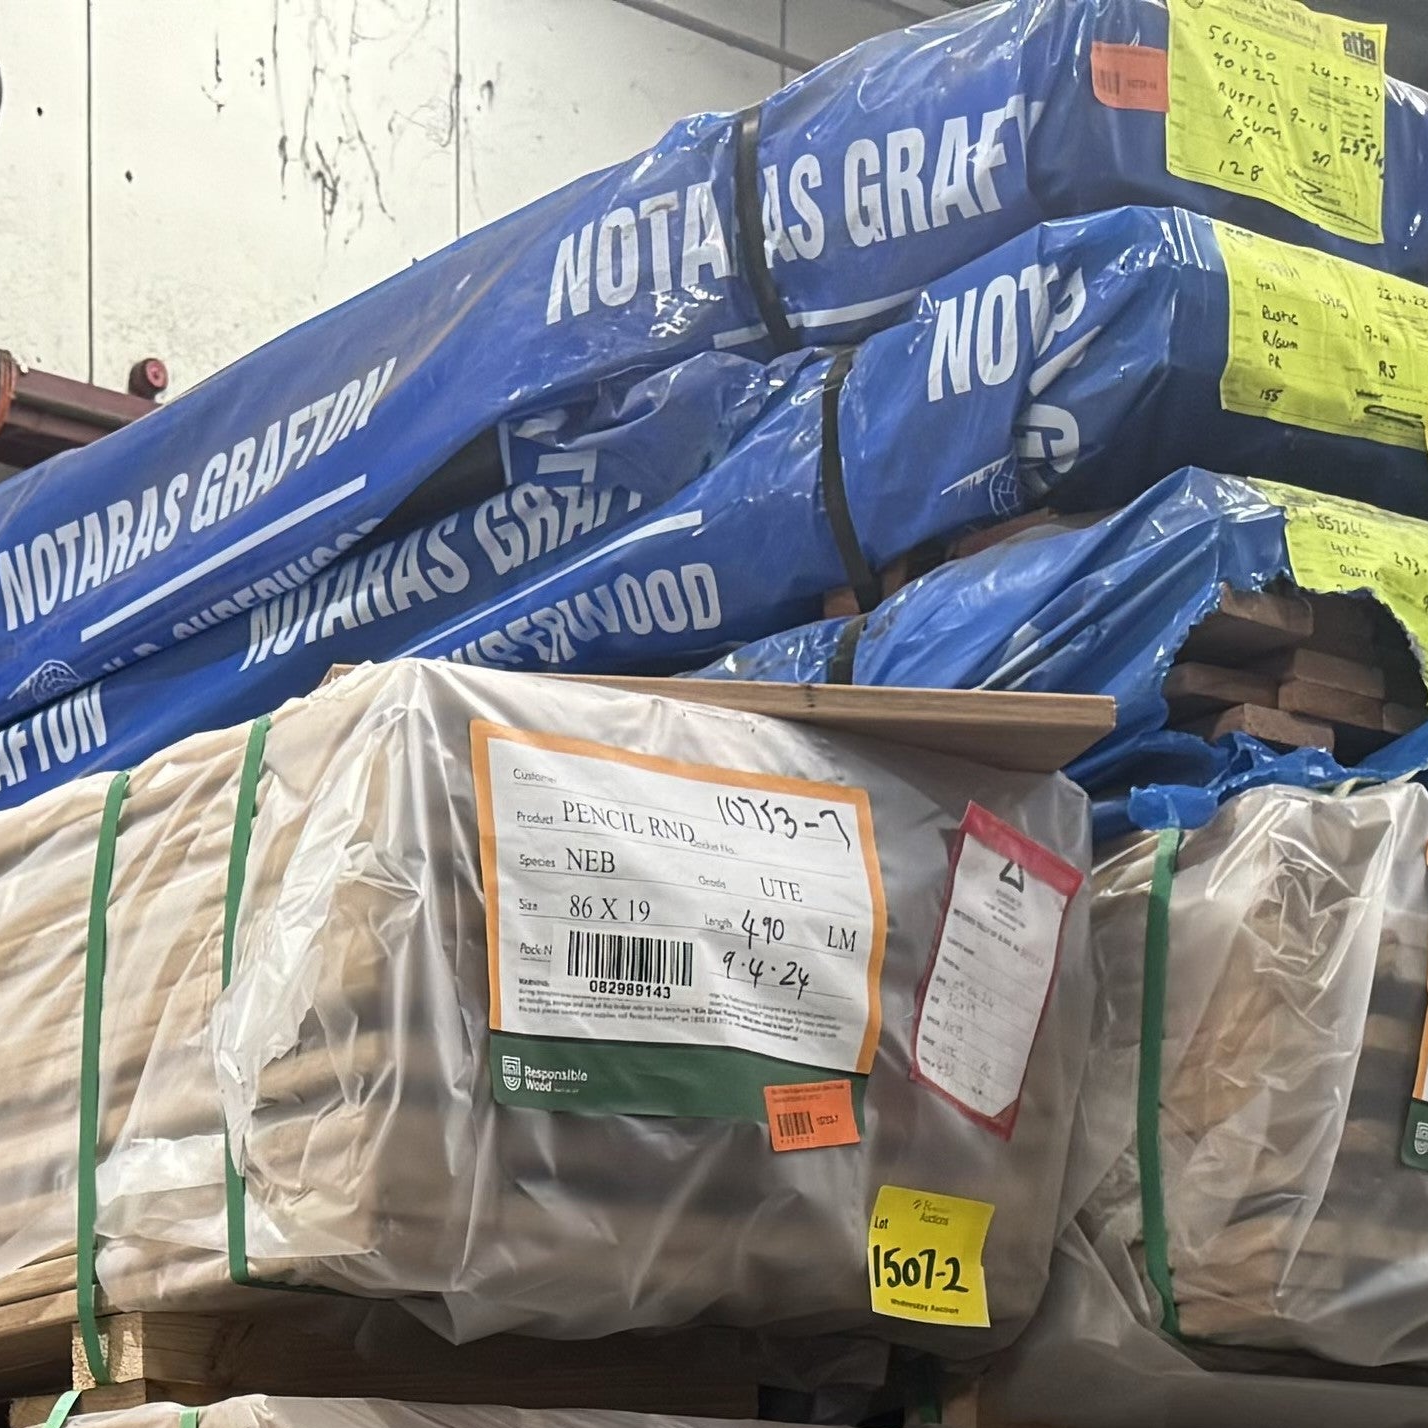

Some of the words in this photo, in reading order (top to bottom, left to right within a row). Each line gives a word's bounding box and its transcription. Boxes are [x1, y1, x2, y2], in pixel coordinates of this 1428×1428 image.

[1208, 25, 1276, 61] 561520
[1219, 160, 1264, 179] 128
[190, 358, 398, 536] GRAFTON
[240, 511, 472, 671] NOTARAS
[516, 810, 555, 827] Product
[562, 800, 644, 839] PENCIL
[647, 816, 695, 845] RND
[716, 794, 852, 853] 10753-7
[519, 853, 556, 870] Species
[565, 846, 617, 876] NEB
[759, 875, 804, 905] UTE
[568, 894, 594, 919] 86
[600, 897, 619, 923] X
[626, 898, 651, 924] 19
[739, 910, 787, 951] 490
[827, 924, 858, 953] LM
[588, 977, 672, 1001] 082989143
[524, 1065, 588, 1086] Responsible
[524, 1077, 552, 1094] Wood
[874, 1215, 890, 1231] Lot
[873, 1244, 970, 1294] 1507-2
